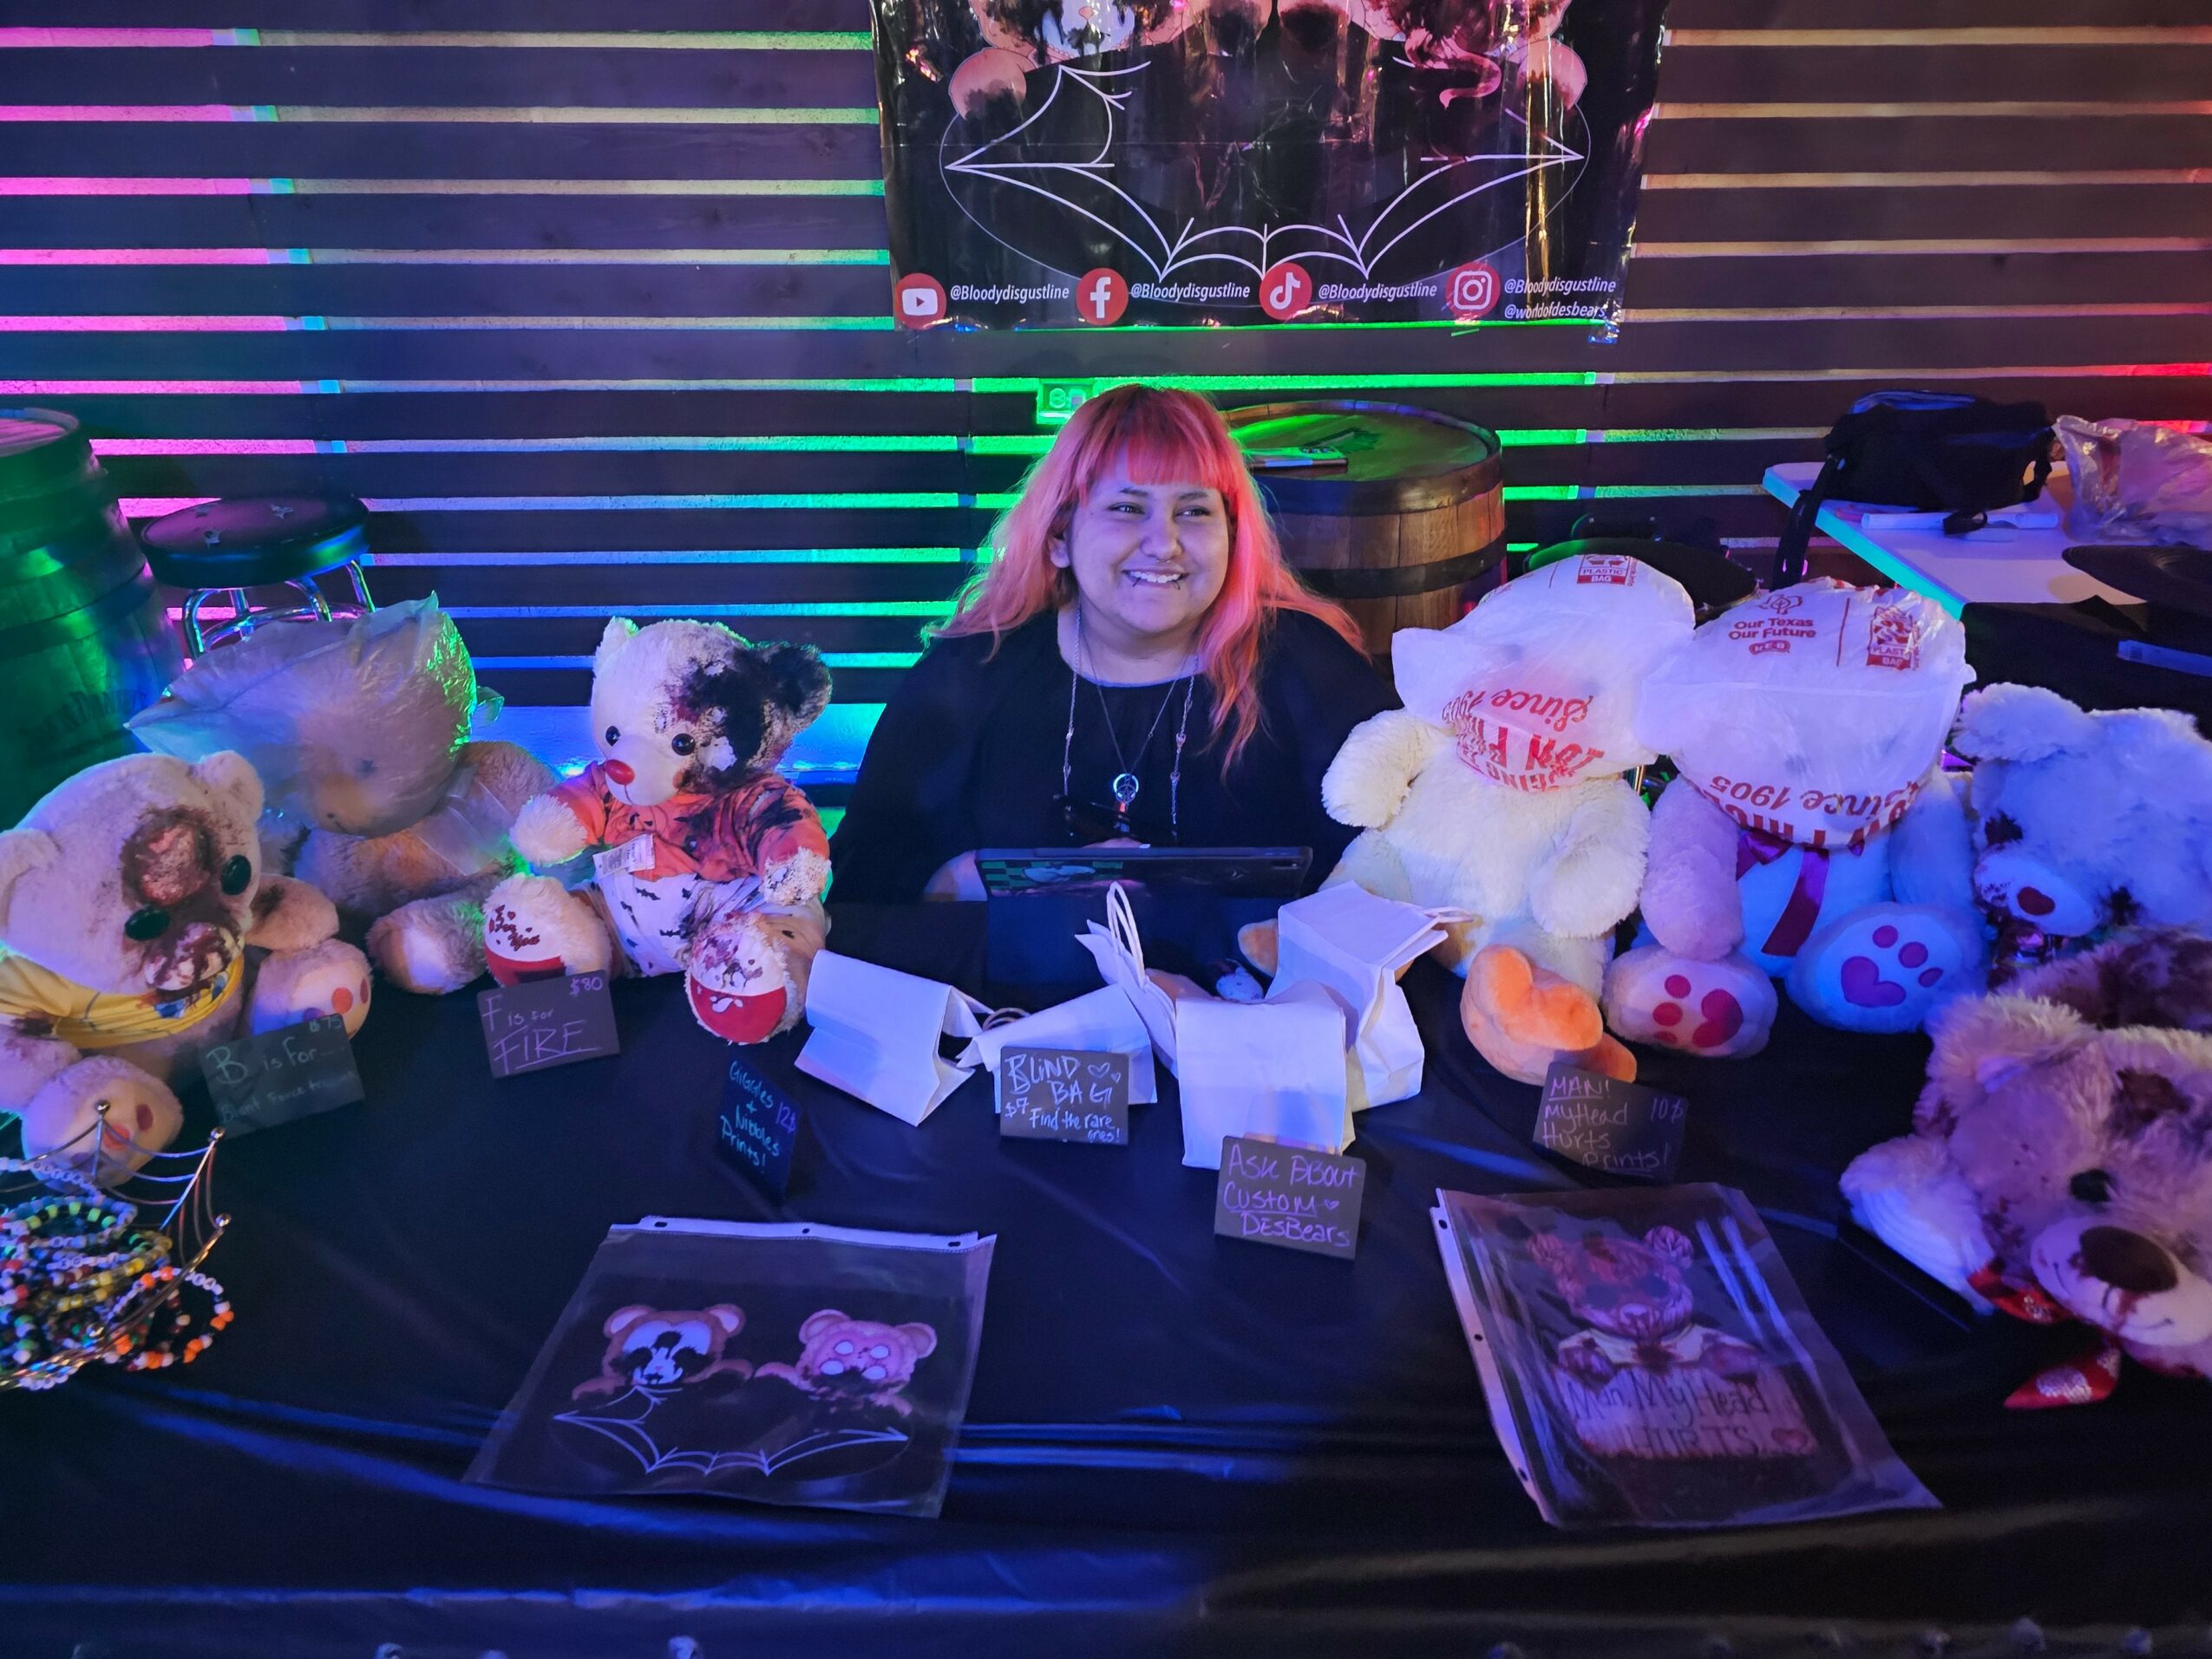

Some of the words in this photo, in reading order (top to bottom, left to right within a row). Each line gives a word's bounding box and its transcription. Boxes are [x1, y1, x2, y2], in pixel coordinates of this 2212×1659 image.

[950, 282, 1070, 304] @Bloodydisgustline
[1130, 281, 1250, 303] @Bloodydisgustline
[1318, 281, 1437, 303] @Bloodydisgustline
[1504, 277, 1616, 295] @Bloodydisgustline
[1504, 301, 1606, 320] @worldofdesbears
[1728, 629, 1759, 640] Our
[1762, 627, 1816, 638] Future
[1734, 619, 1764, 630] Our
[1767, 617, 1814, 627] Texas
[1874, 644, 1908, 656] PLAST
[1491, 689, 1594, 732] Since
[1711, 774, 1790, 810] 1905
[569, 976, 603, 997] $80
[492, 1018, 589, 1076] FIRE
[206, 1045, 249, 1085] B
[263, 1055, 284, 1072] is
[776, 1101, 796, 1134] 12$
[1005, 1096, 1031, 1119] $7
[1651, 1096, 1684, 1125] 10$
[1029, 1106, 1060, 1132] Find
[1061, 1109, 1083, 1132] the
[1083, 1113, 1116, 1130] rare
